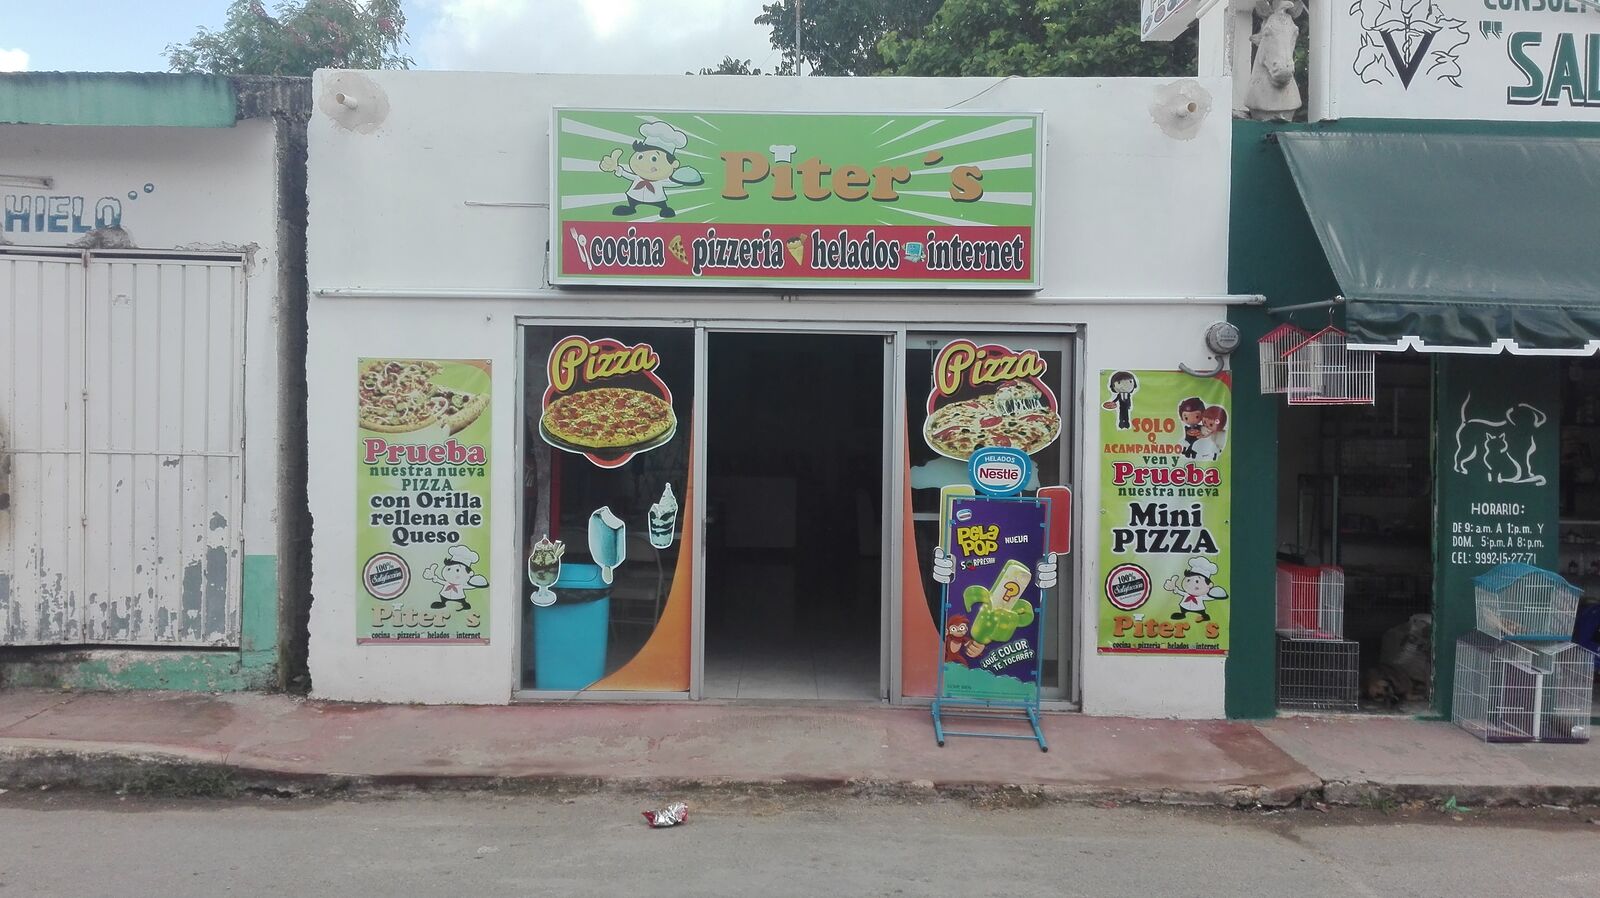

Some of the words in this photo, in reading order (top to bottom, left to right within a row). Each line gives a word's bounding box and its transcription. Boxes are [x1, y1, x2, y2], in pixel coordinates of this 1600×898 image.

[5, 195, 122, 232] HIELO
[590, 227, 665, 267] cocina
[692, 228, 784, 276] pizzeria
[811, 229, 901, 270] helados
[926, 230, 1025, 271] internet
[552, 339, 656, 391] Pizza
[938, 343, 1043, 395] Pizza
[1132, 418, 1176, 433] SOLO
[363, 437, 488, 466] Prueba
[984, 456, 1016, 464] HELADOS
[1143, 456, 1168, 465] ven
[1171, 456, 1180, 467] y
[369, 466, 432, 477] nuestra
[437, 466, 485, 477] nueva
[1113, 461, 1222, 486] Prueba
[401, 478, 453, 491] PIZZA
[1118, 486, 1174, 497] nuestra
[1178, 487, 1219, 497] nueva
[370, 496, 410, 508] con
[416, 492, 482, 508] Orilla
[1129, 503, 1203, 527] Mini
[1471, 502, 1525, 515] HORARIO:
[371, 509, 449, 525] rellena
[455, 510, 481, 525] de
[1452, 522, 1463, 533] DE
[1496, 523, 1503, 533] A
[1537, 523, 1545, 534] Y
[392, 526, 460, 546] Queso
[1112, 529, 1219, 553] PIZZA
[1452, 535, 1474, 548] DOM.
[1507, 537, 1513, 548] A
[962, 540, 998, 556] POP
[1451, 551, 1472, 564] CEL:
[1117, 572, 1137, 583] 100%
[371, 631, 391, 639] cocina
[397, 631, 421, 640] pizzeria
[427, 631, 450, 639] helados
[997, 640, 1028, 658] COLOR
[1167, 642, 1190, 650] helados
[993, 662, 1003, 671] TE
